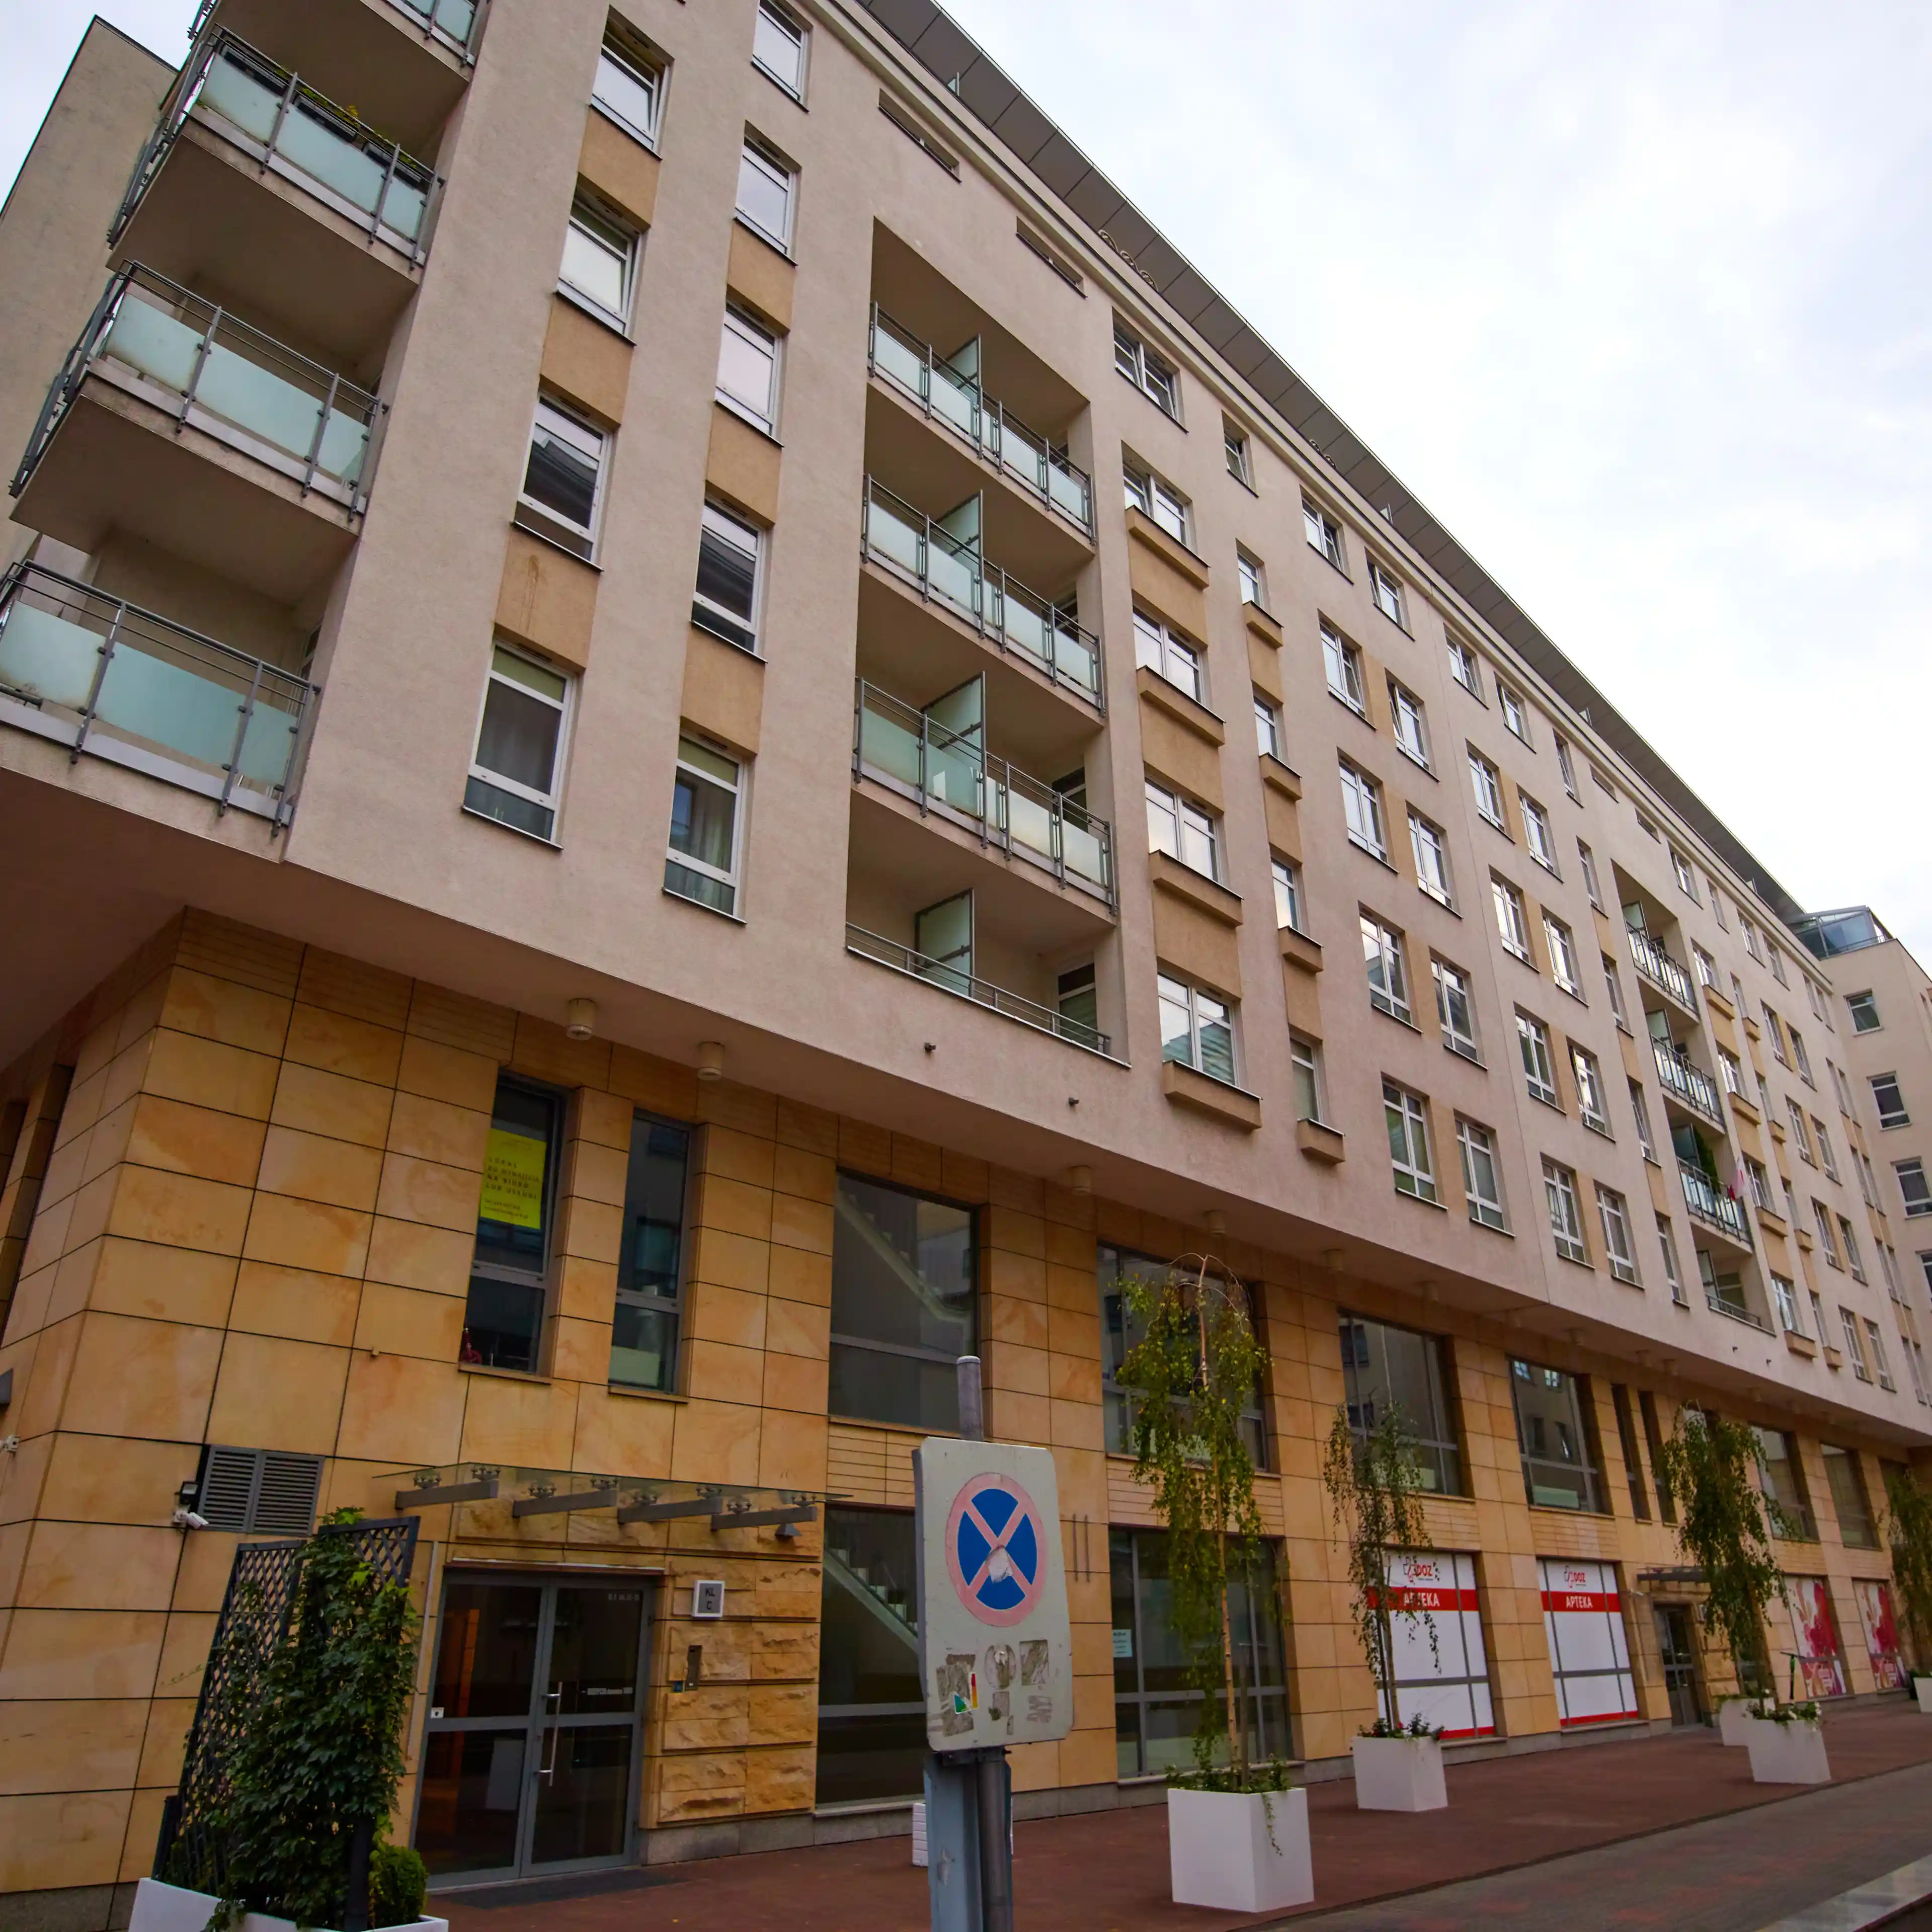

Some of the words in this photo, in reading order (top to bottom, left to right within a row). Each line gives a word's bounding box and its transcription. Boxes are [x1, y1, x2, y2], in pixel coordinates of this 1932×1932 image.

[487, 1173, 498, 1181] NA
[705, 1587, 715, 1596] KL
[1566, 1595, 1593, 1609] APTEKA
